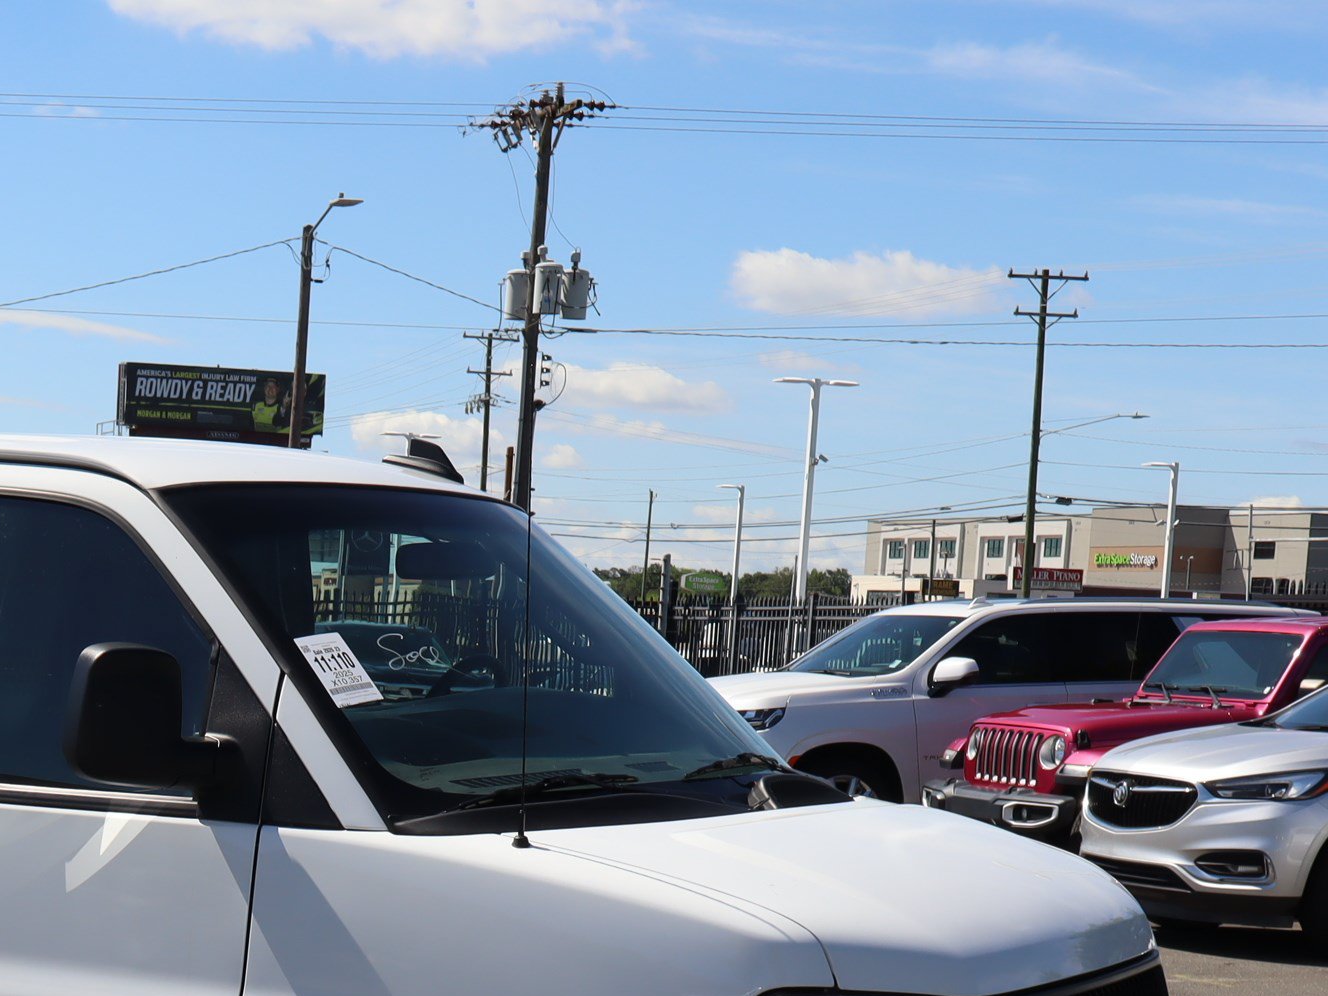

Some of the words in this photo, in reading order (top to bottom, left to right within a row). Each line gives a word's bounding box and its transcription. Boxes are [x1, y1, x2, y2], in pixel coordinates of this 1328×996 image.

[136, 368, 172, 378] AMERICA'S
[172, 371, 201, 380] LARGEST
[201, 372, 225, 382] INJURY
[225, 374, 240, 382] LAW
[135, 377, 192, 400] ROWDY
[192, 382, 204, 400] &
[205, 382, 256, 403] READY
[136, 409, 161, 419] MORGAN
[167, 411, 192, 421] MORGAN
[1053, 570, 1081, 582] PIANO
[313, 651, 356, 674] 11:110
[332, 669, 354, 679] 2025
